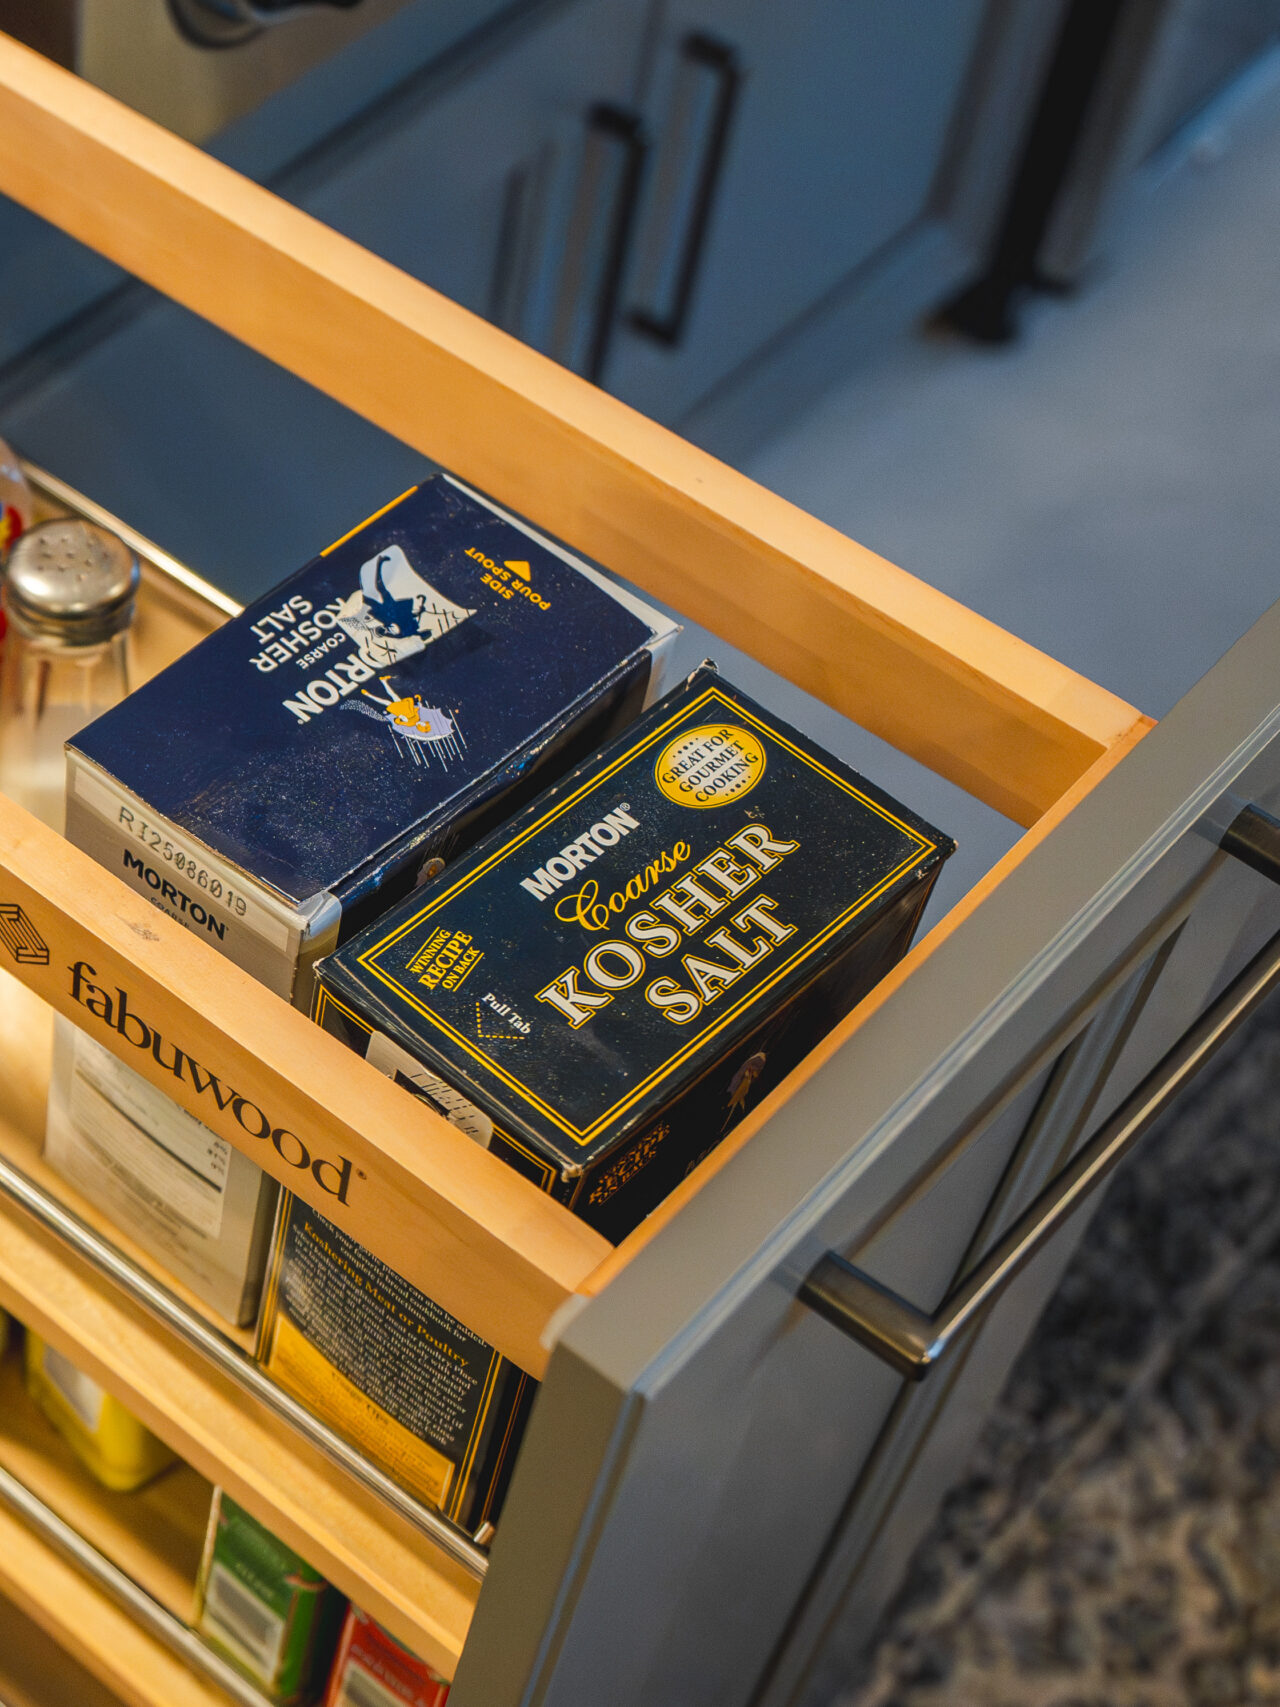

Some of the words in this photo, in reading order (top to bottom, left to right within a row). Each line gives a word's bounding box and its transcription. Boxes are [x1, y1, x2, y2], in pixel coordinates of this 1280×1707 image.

[464, 547, 511, 581] SPOUT
[480, 573, 514, 599] SIDE
[250, 595, 313, 644] SALT
[511, 579, 551, 610] POUR
[296, 632, 346, 670] COARSE
[662, 749, 706, 783] GREAT
[702, 729, 734, 752] FOR
[679, 740, 745, 792] GOURMET
[695, 752, 759, 802] COOKING
[519, 807, 640, 901] MORTON
[123, 849, 226, 941] MORTON
[554, 841, 691, 931] Coarse
[409, 929, 452, 974] WINNING
[534, 824, 800, 1030] KOSHER
[418, 930, 473, 990] RECIPE
[441, 972, 460, 989] ON
[453, 946, 480, 975] BACK
[645, 893, 799, 1025] SALT
[482, 992, 511, 1016] Pull
[508, 1013, 531, 1034] Tab
[67, 961, 353, 1207] fabuwood
[304, 1220, 362, 1287] Koshering
[365, 1280, 395, 1313] Meat
[398, 1311, 414, 1328] or
[416, 1323, 468, 1370] Poultry
[334, 1230, 352, 1249] your
[354, 1246, 384, 1278] favorite
[385, 1273, 408, 1299] bread
[409, 1296, 452, 1332] cookbook
[453, 1328, 466, 1343] for
[340, 1246, 375, 1281] complete
[376, 1277, 427, 1324] instructions.
[382, 1264, 407, 1288] pieces
[408, 1285, 423, 1301] can
[425, 1297, 442, 1315] also
[444, 1312, 455, 1325] be
[456, 1321, 487, 1348] added.
[430, 1356, 450, 1376] with
[451, 1373, 470, 1390] cool
[454, 1364, 477, 1386] Place
